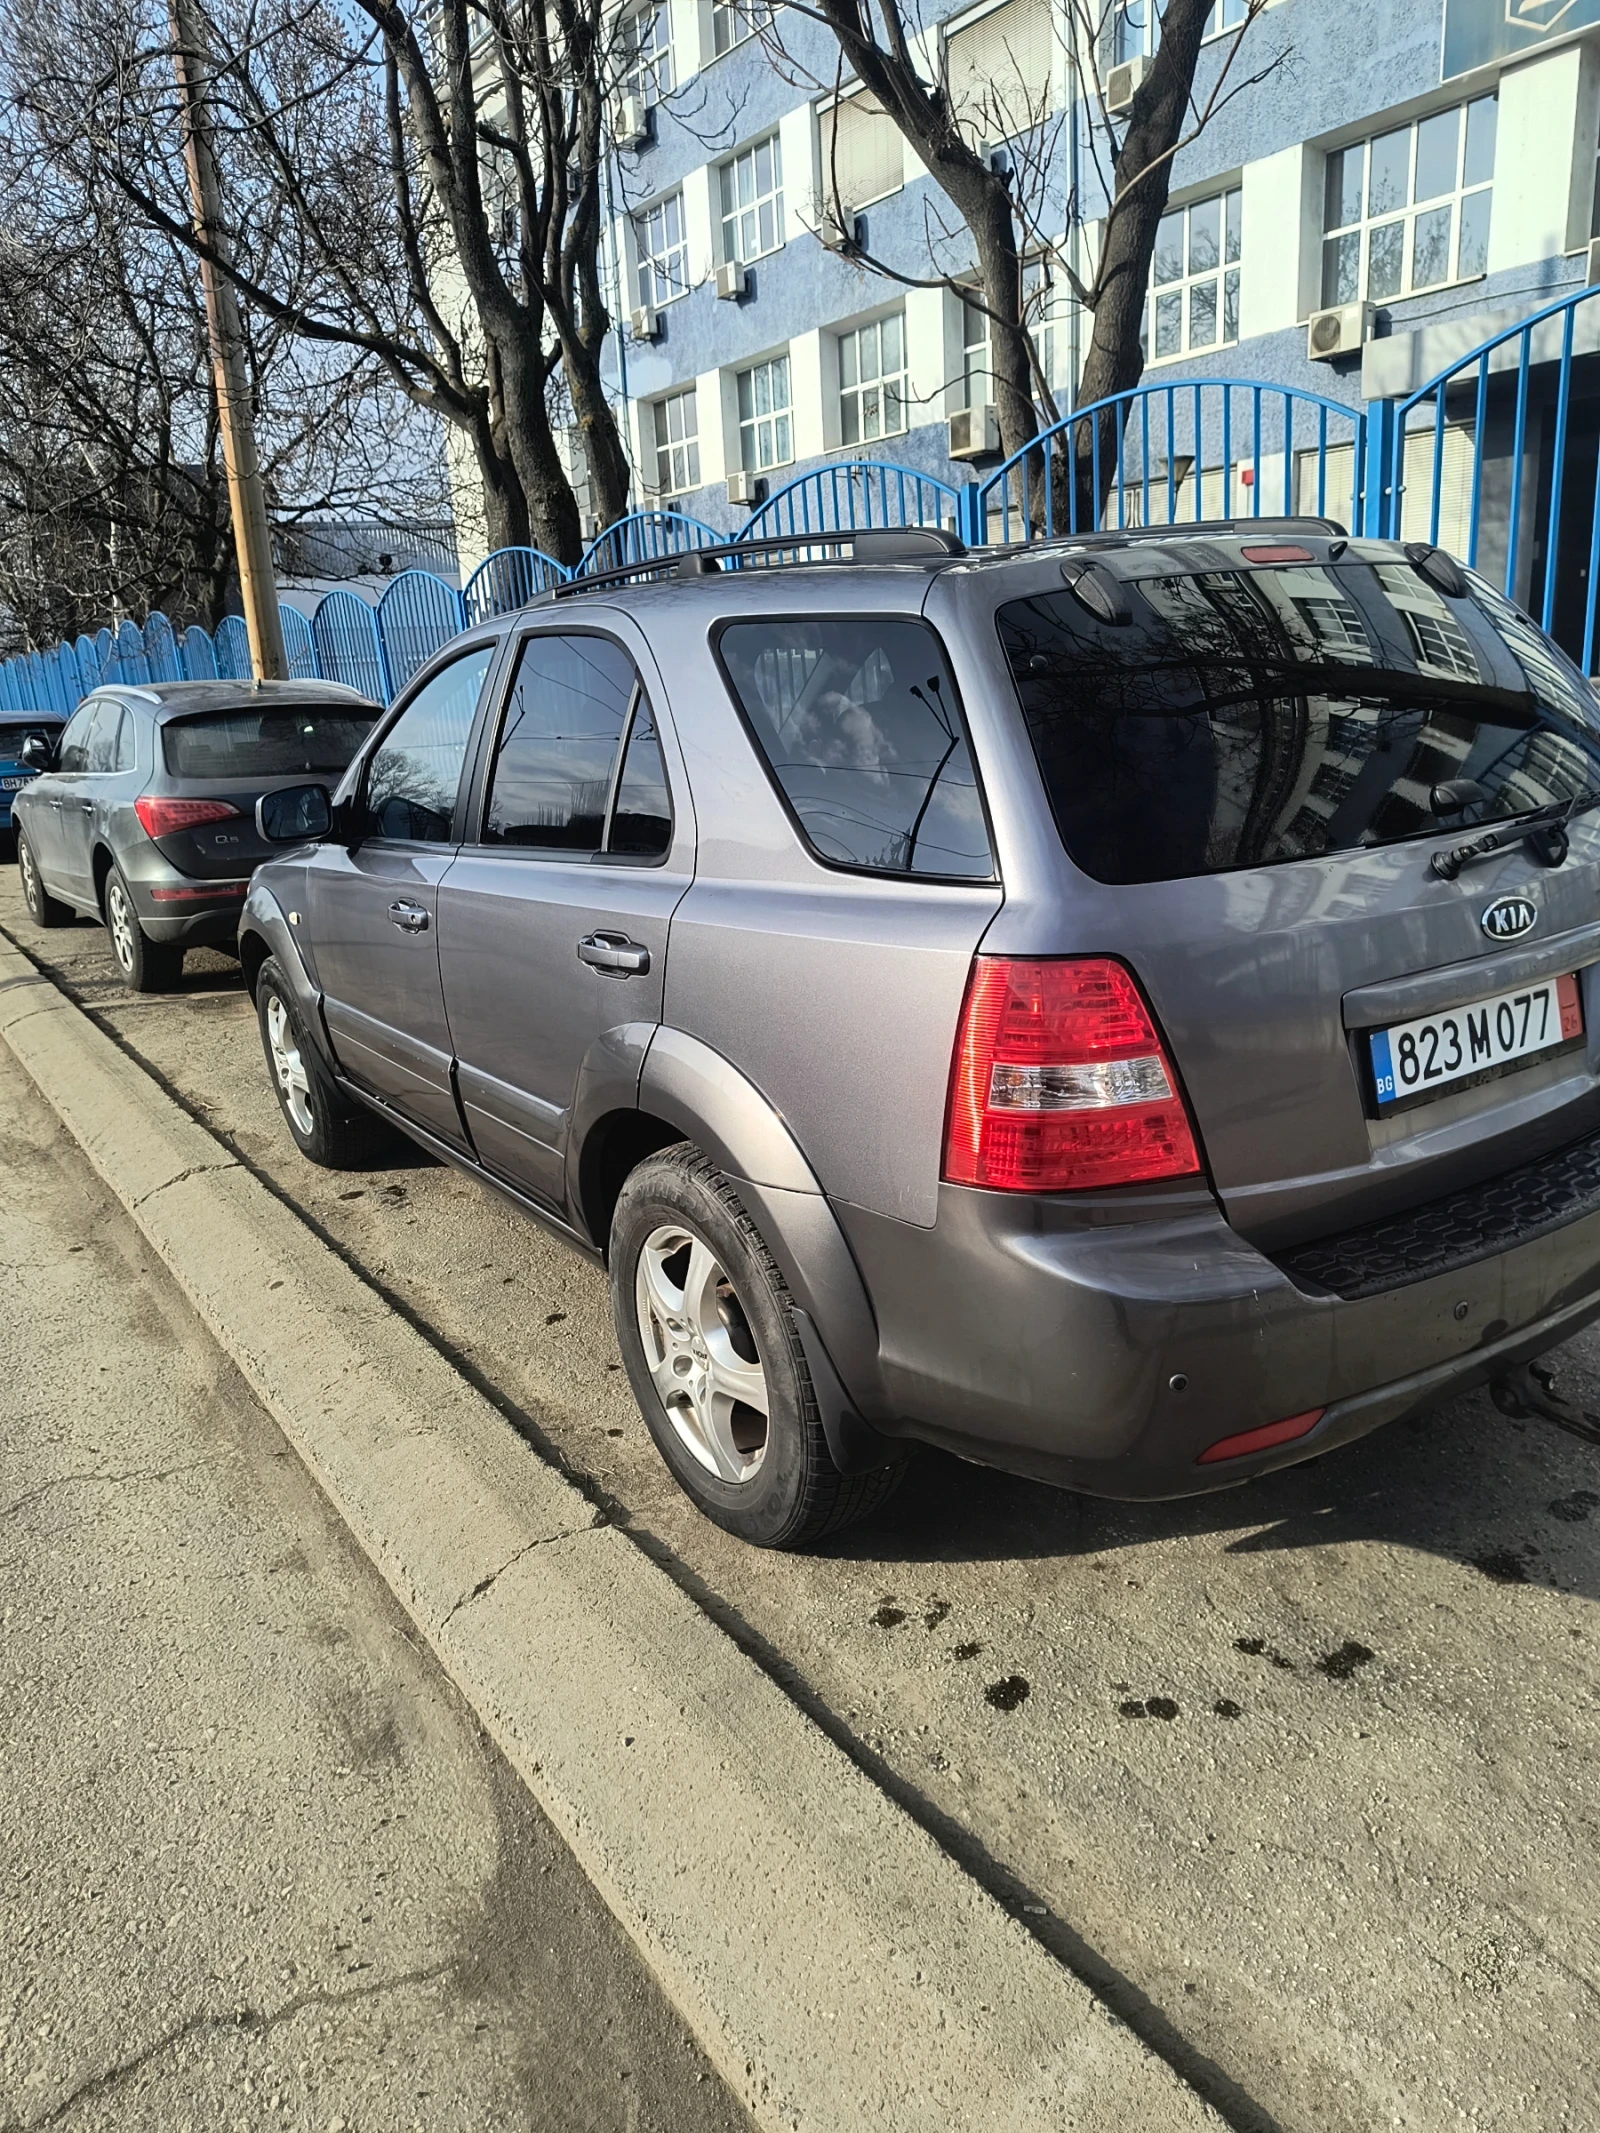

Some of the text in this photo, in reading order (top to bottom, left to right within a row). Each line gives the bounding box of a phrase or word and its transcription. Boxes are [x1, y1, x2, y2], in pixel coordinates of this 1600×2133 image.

[215, 835, 239, 844] Q5
[1493, 904, 1532, 934] KIA
[1376, 1076, 1394, 1094] BG
